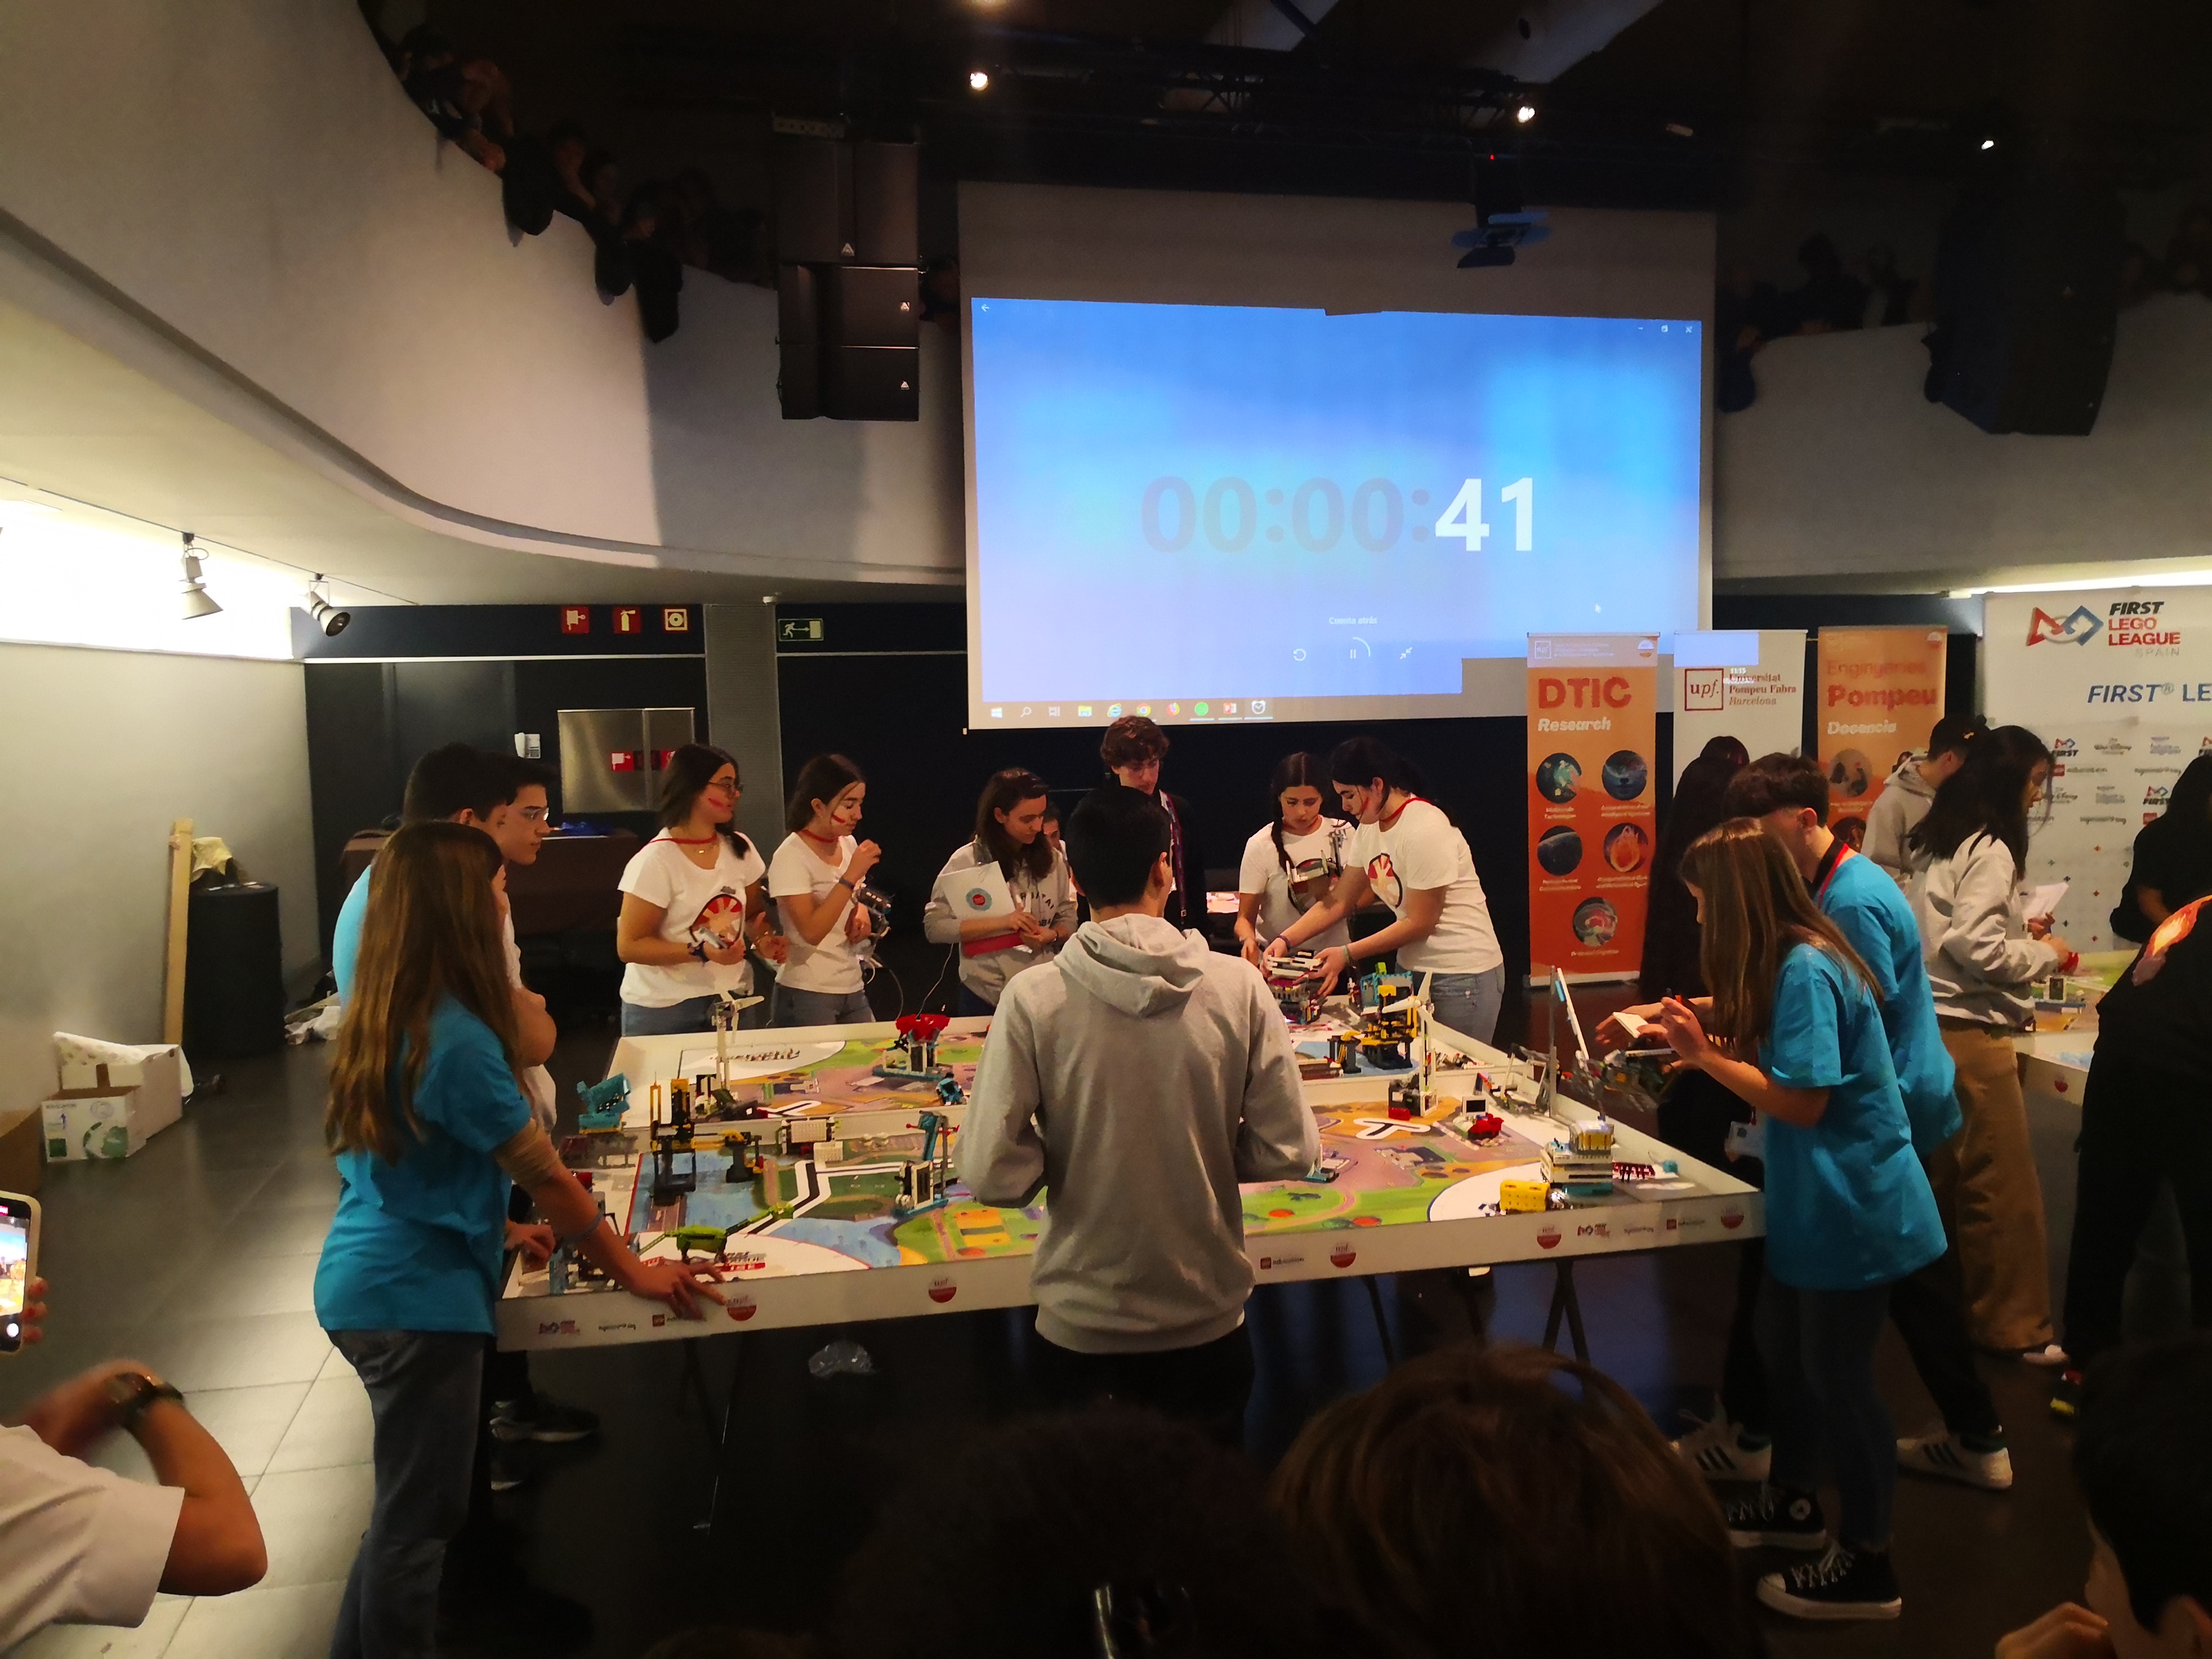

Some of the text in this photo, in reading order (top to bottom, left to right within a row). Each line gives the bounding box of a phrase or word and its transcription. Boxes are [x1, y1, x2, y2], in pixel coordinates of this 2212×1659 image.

[1141, 476, 1534, 553] 00:00:41
[2109, 601, 2165, 615] FIRST
[2108, 617, 2157, 630] LEGO
[2108, 632, 2181, 646] LEAGUE
[2136, 647, 2180, 658] SPAIN
[1538, 677, 1632, 709] DTIC
[1690, 678, 1719, 698] upf.
[1729, 685, 1797, 695] Pompeu Fabra
[2182, 683, 2212, 702] LE
[1828, 685, 1937, 711] Pompeu
[1537, 716, 1612, 732] Research
